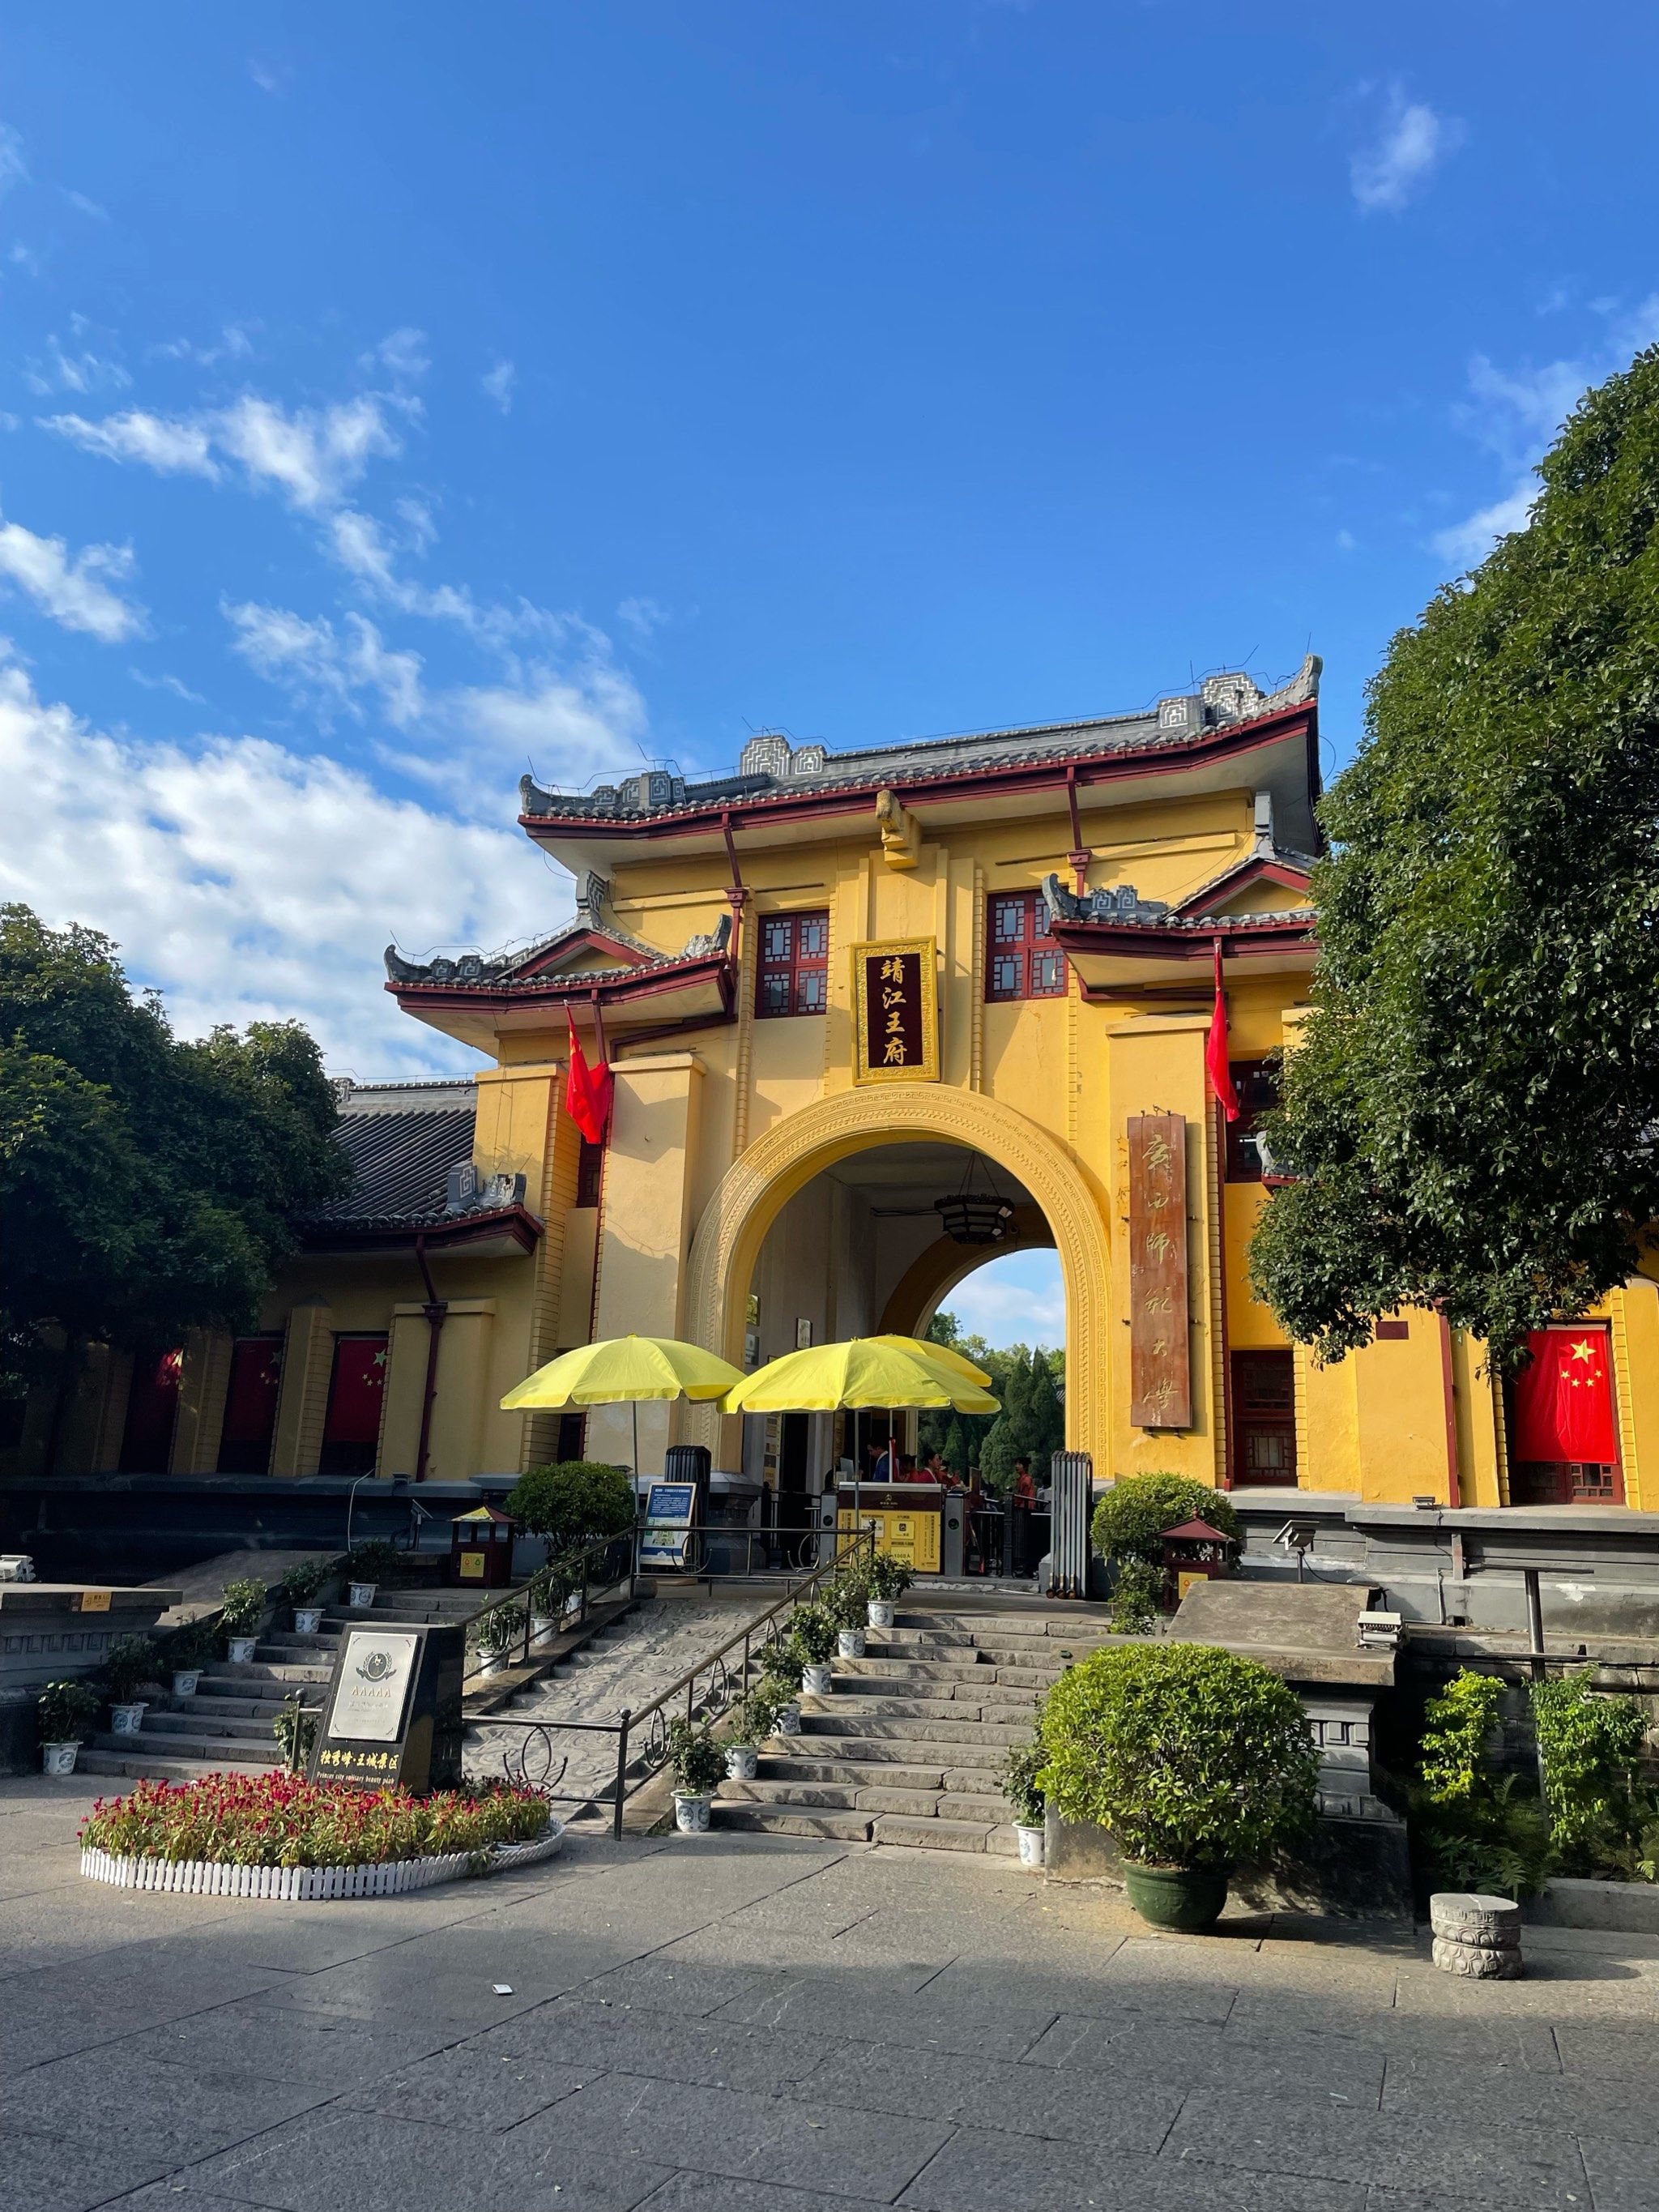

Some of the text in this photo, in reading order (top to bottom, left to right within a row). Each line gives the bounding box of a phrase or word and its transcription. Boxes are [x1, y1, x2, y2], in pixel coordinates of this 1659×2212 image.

[880, 957, 908, 1065] 靖江王府
[352, 1685, 391, 1698] AAAAA
[335, 1772, 344, 1781] city
[365, 1775, 382, 1784] beauty
